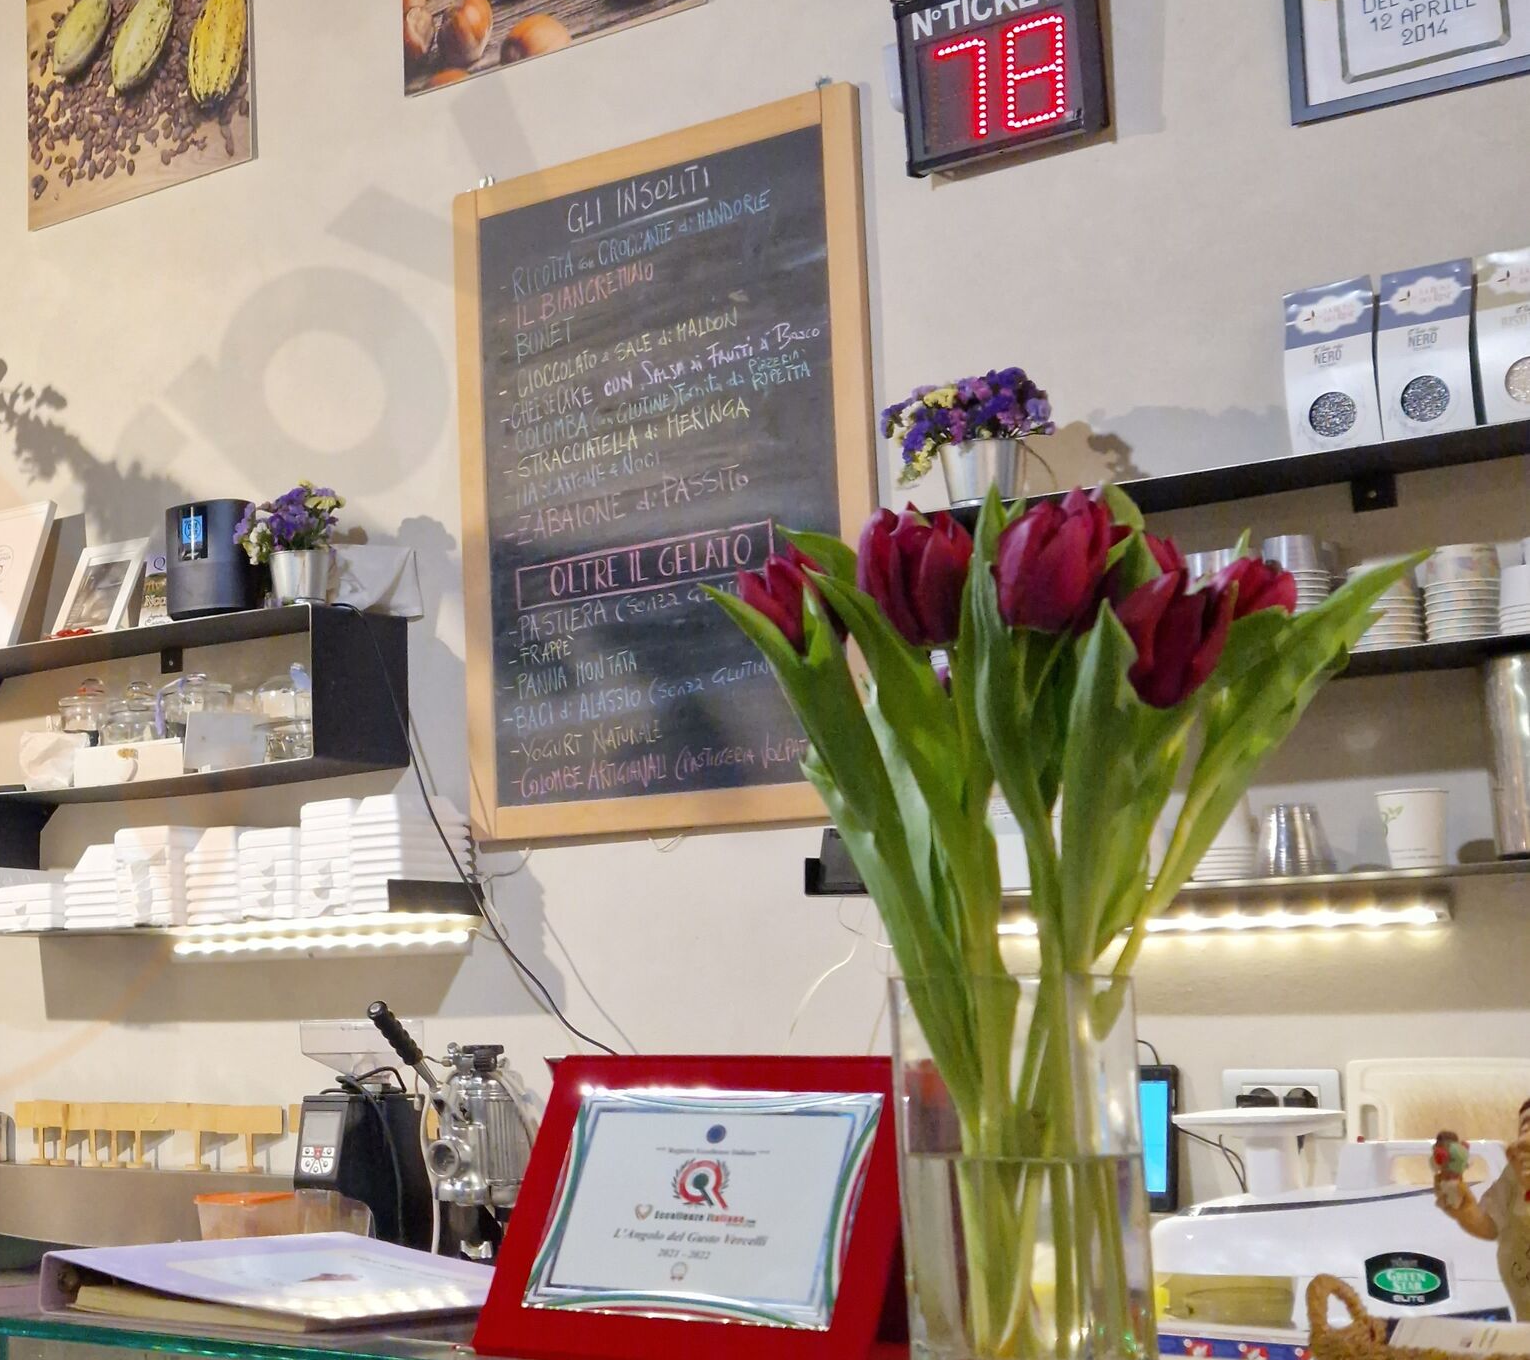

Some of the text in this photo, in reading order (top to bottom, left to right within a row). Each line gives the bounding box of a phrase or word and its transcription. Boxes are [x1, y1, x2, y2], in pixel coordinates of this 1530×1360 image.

[1369, 11, 1395, 32] 12
[1401, 19, 1451, 47] 2014
[933, 12, 1066, 137] 78
[568, 164, 710, 235] GLI INSOLITI
[1313, 348, 1342, 365] NERO
[1408, 332, 1438, 348] NERO
[518, 426, 637, 478] STRACCIATELLA
[668, 396, 750, 439] MERINGA
[550, 533, 752, 597] OLTRE IL GELATO
[519, 599, 606, 643] PASTIERA
[514, 703, 555, 737] BACI
[713, 662, 769, 685] GLUTIN
[517, 670, 567, 700] PANNA
[1392, 1294, 1426, 1303] ELITE
